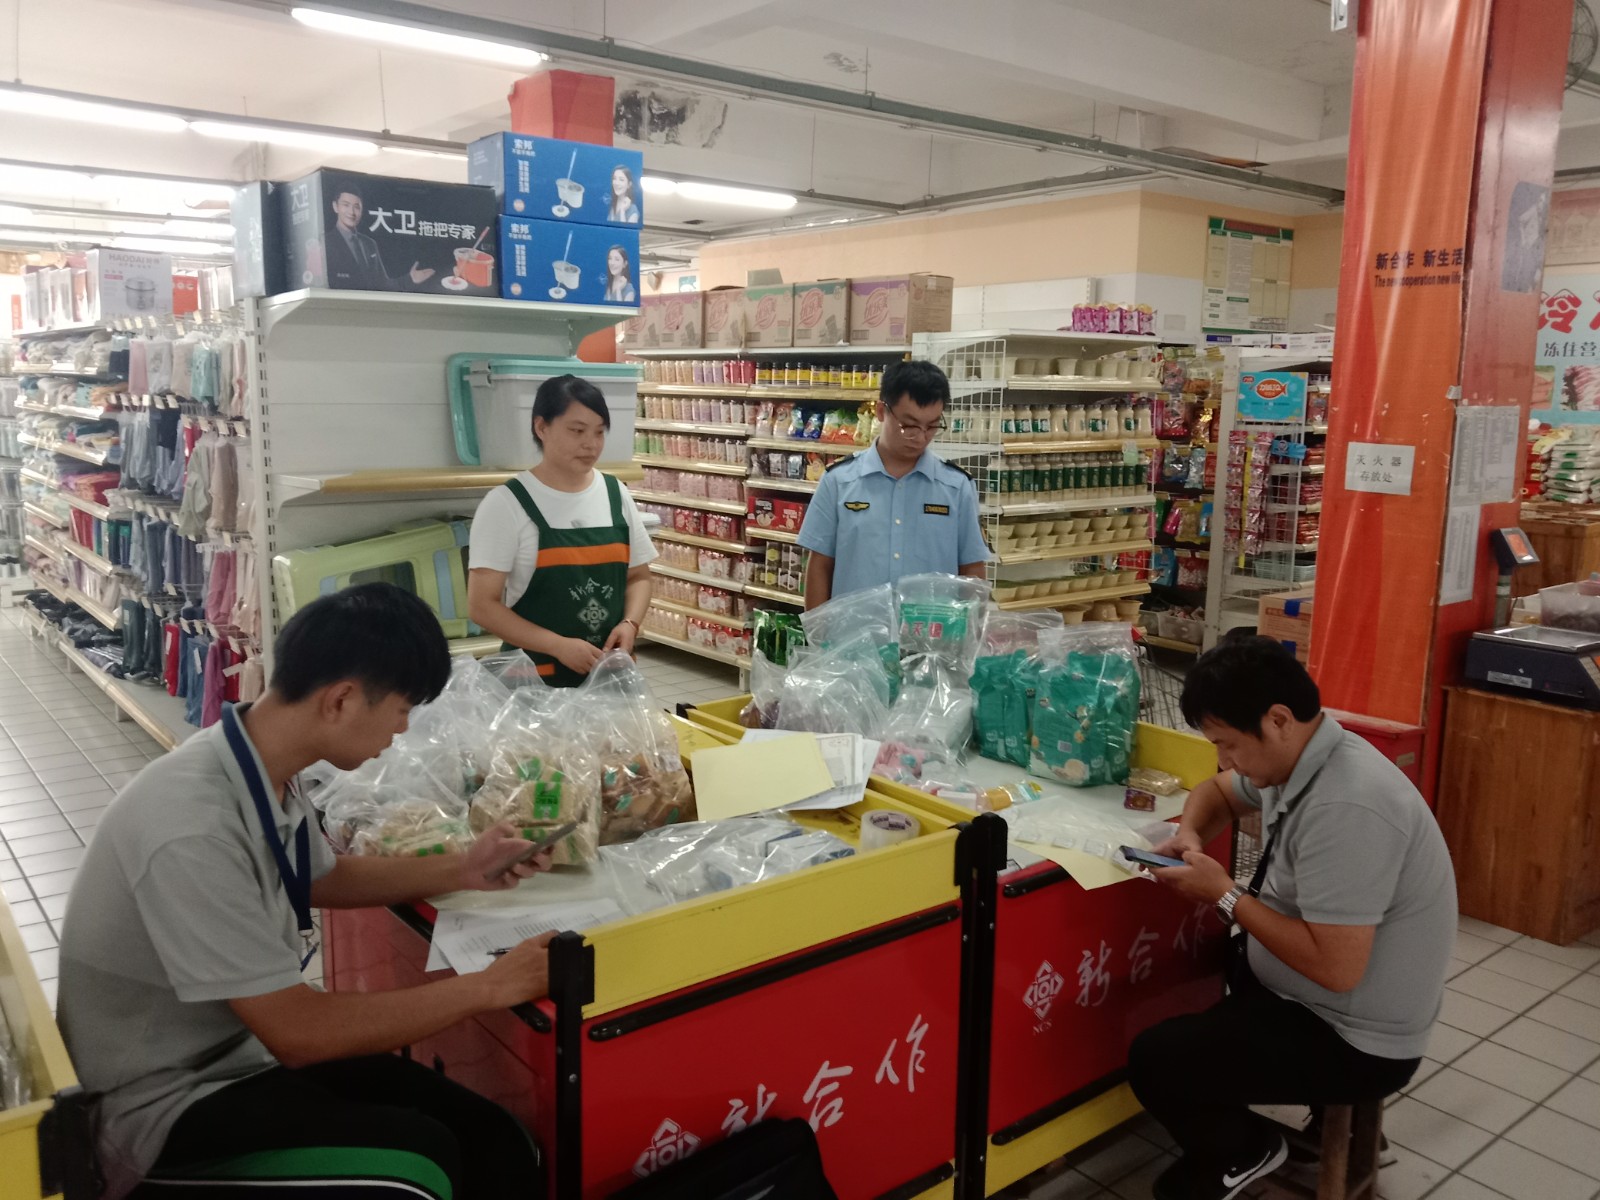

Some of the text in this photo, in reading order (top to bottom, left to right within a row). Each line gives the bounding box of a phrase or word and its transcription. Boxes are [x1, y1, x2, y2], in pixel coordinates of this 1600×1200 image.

[368, 206, 477, 240] 大卫 拖把专家
[1376, 247, 1463, 270] 新合作 新生活
[1538, 289, 1600, 334] 冷
[1356, 454, 1402, 467] 灭火器
[1360, 470, 1393, 483] 存放处
